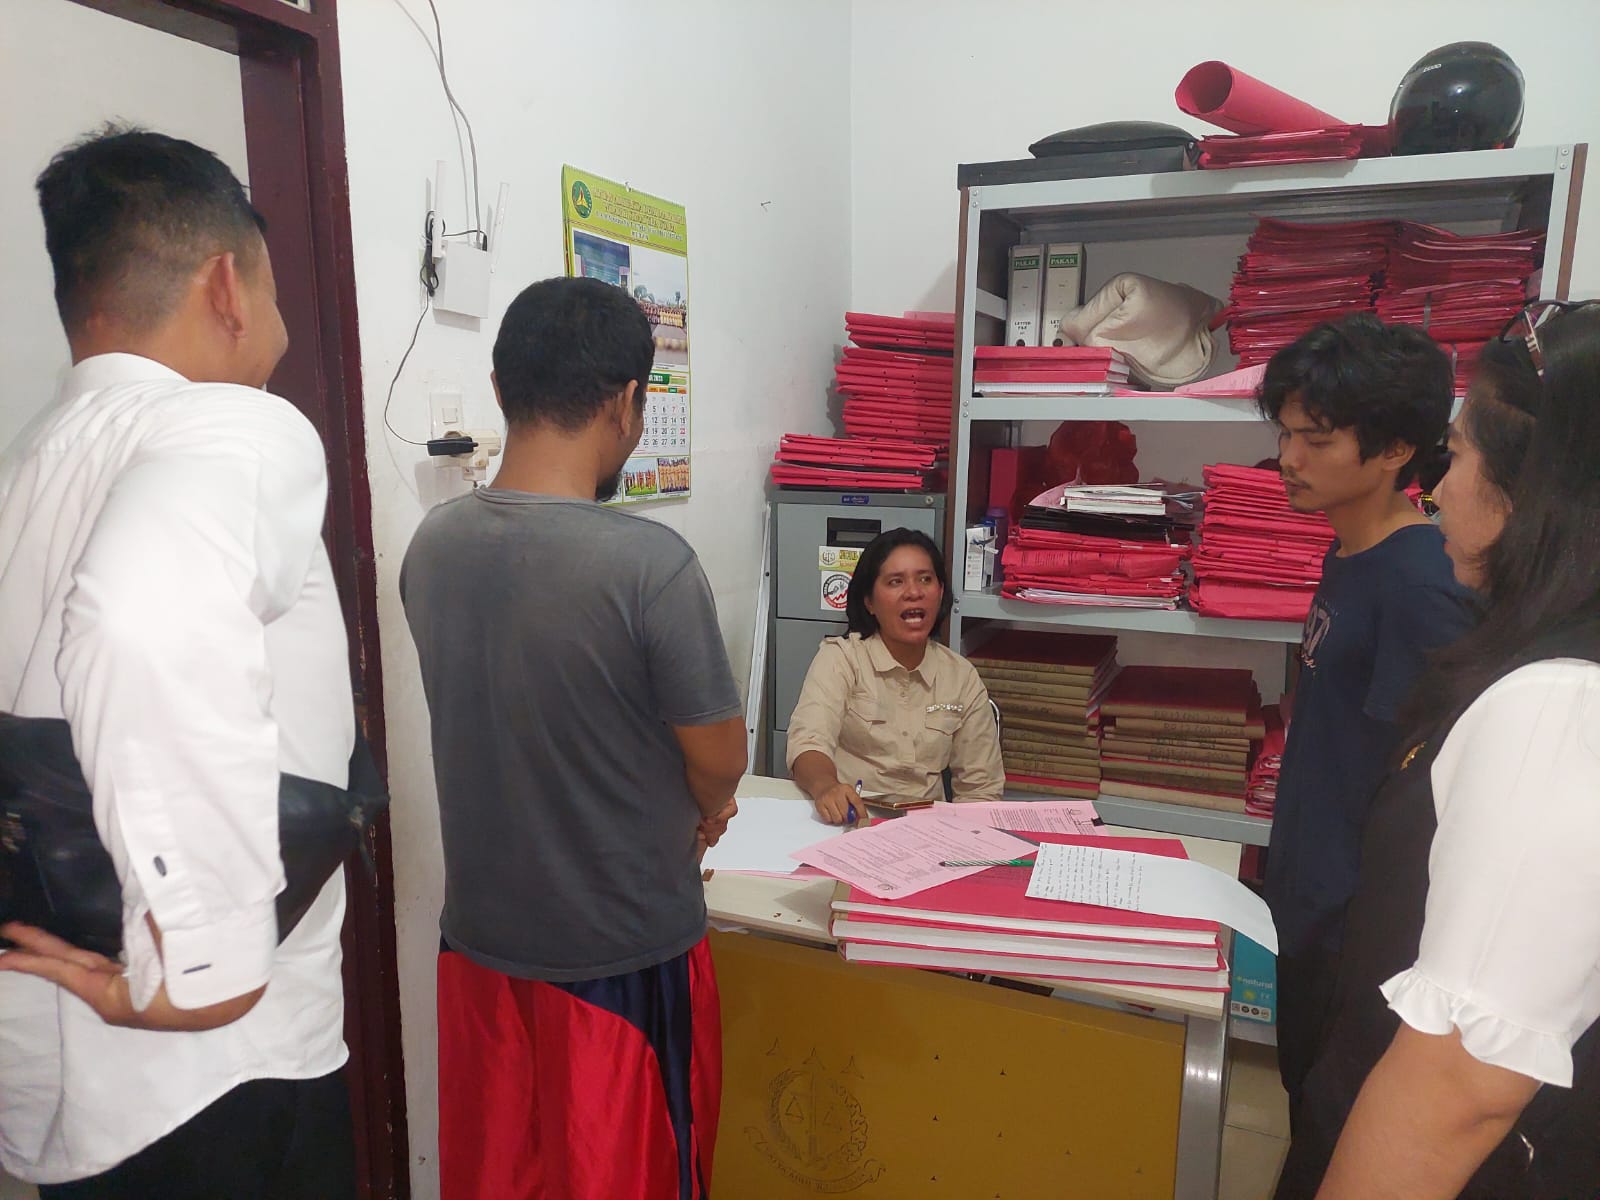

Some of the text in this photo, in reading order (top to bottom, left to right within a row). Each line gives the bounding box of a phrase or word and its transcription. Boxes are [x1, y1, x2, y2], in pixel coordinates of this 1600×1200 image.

[652, 405, 657, 413] 5
[662, 405, 666, 413] 6
[651, 416, 658, 424] 12
[661, 416, 668, 424] 13
[680, 416, 686, 424] 15
[651, 427, 658, 435] 19
[661, 427, 668, 435] 20
[670, 427, 677, 435] 21
[679, 427, 686, 435] 22
[643, 438, 649, 446] 25
[652, 438, 658, 446] 26
[661, 438, 668, 446] 27
[670, 438, 677, 446] 28
